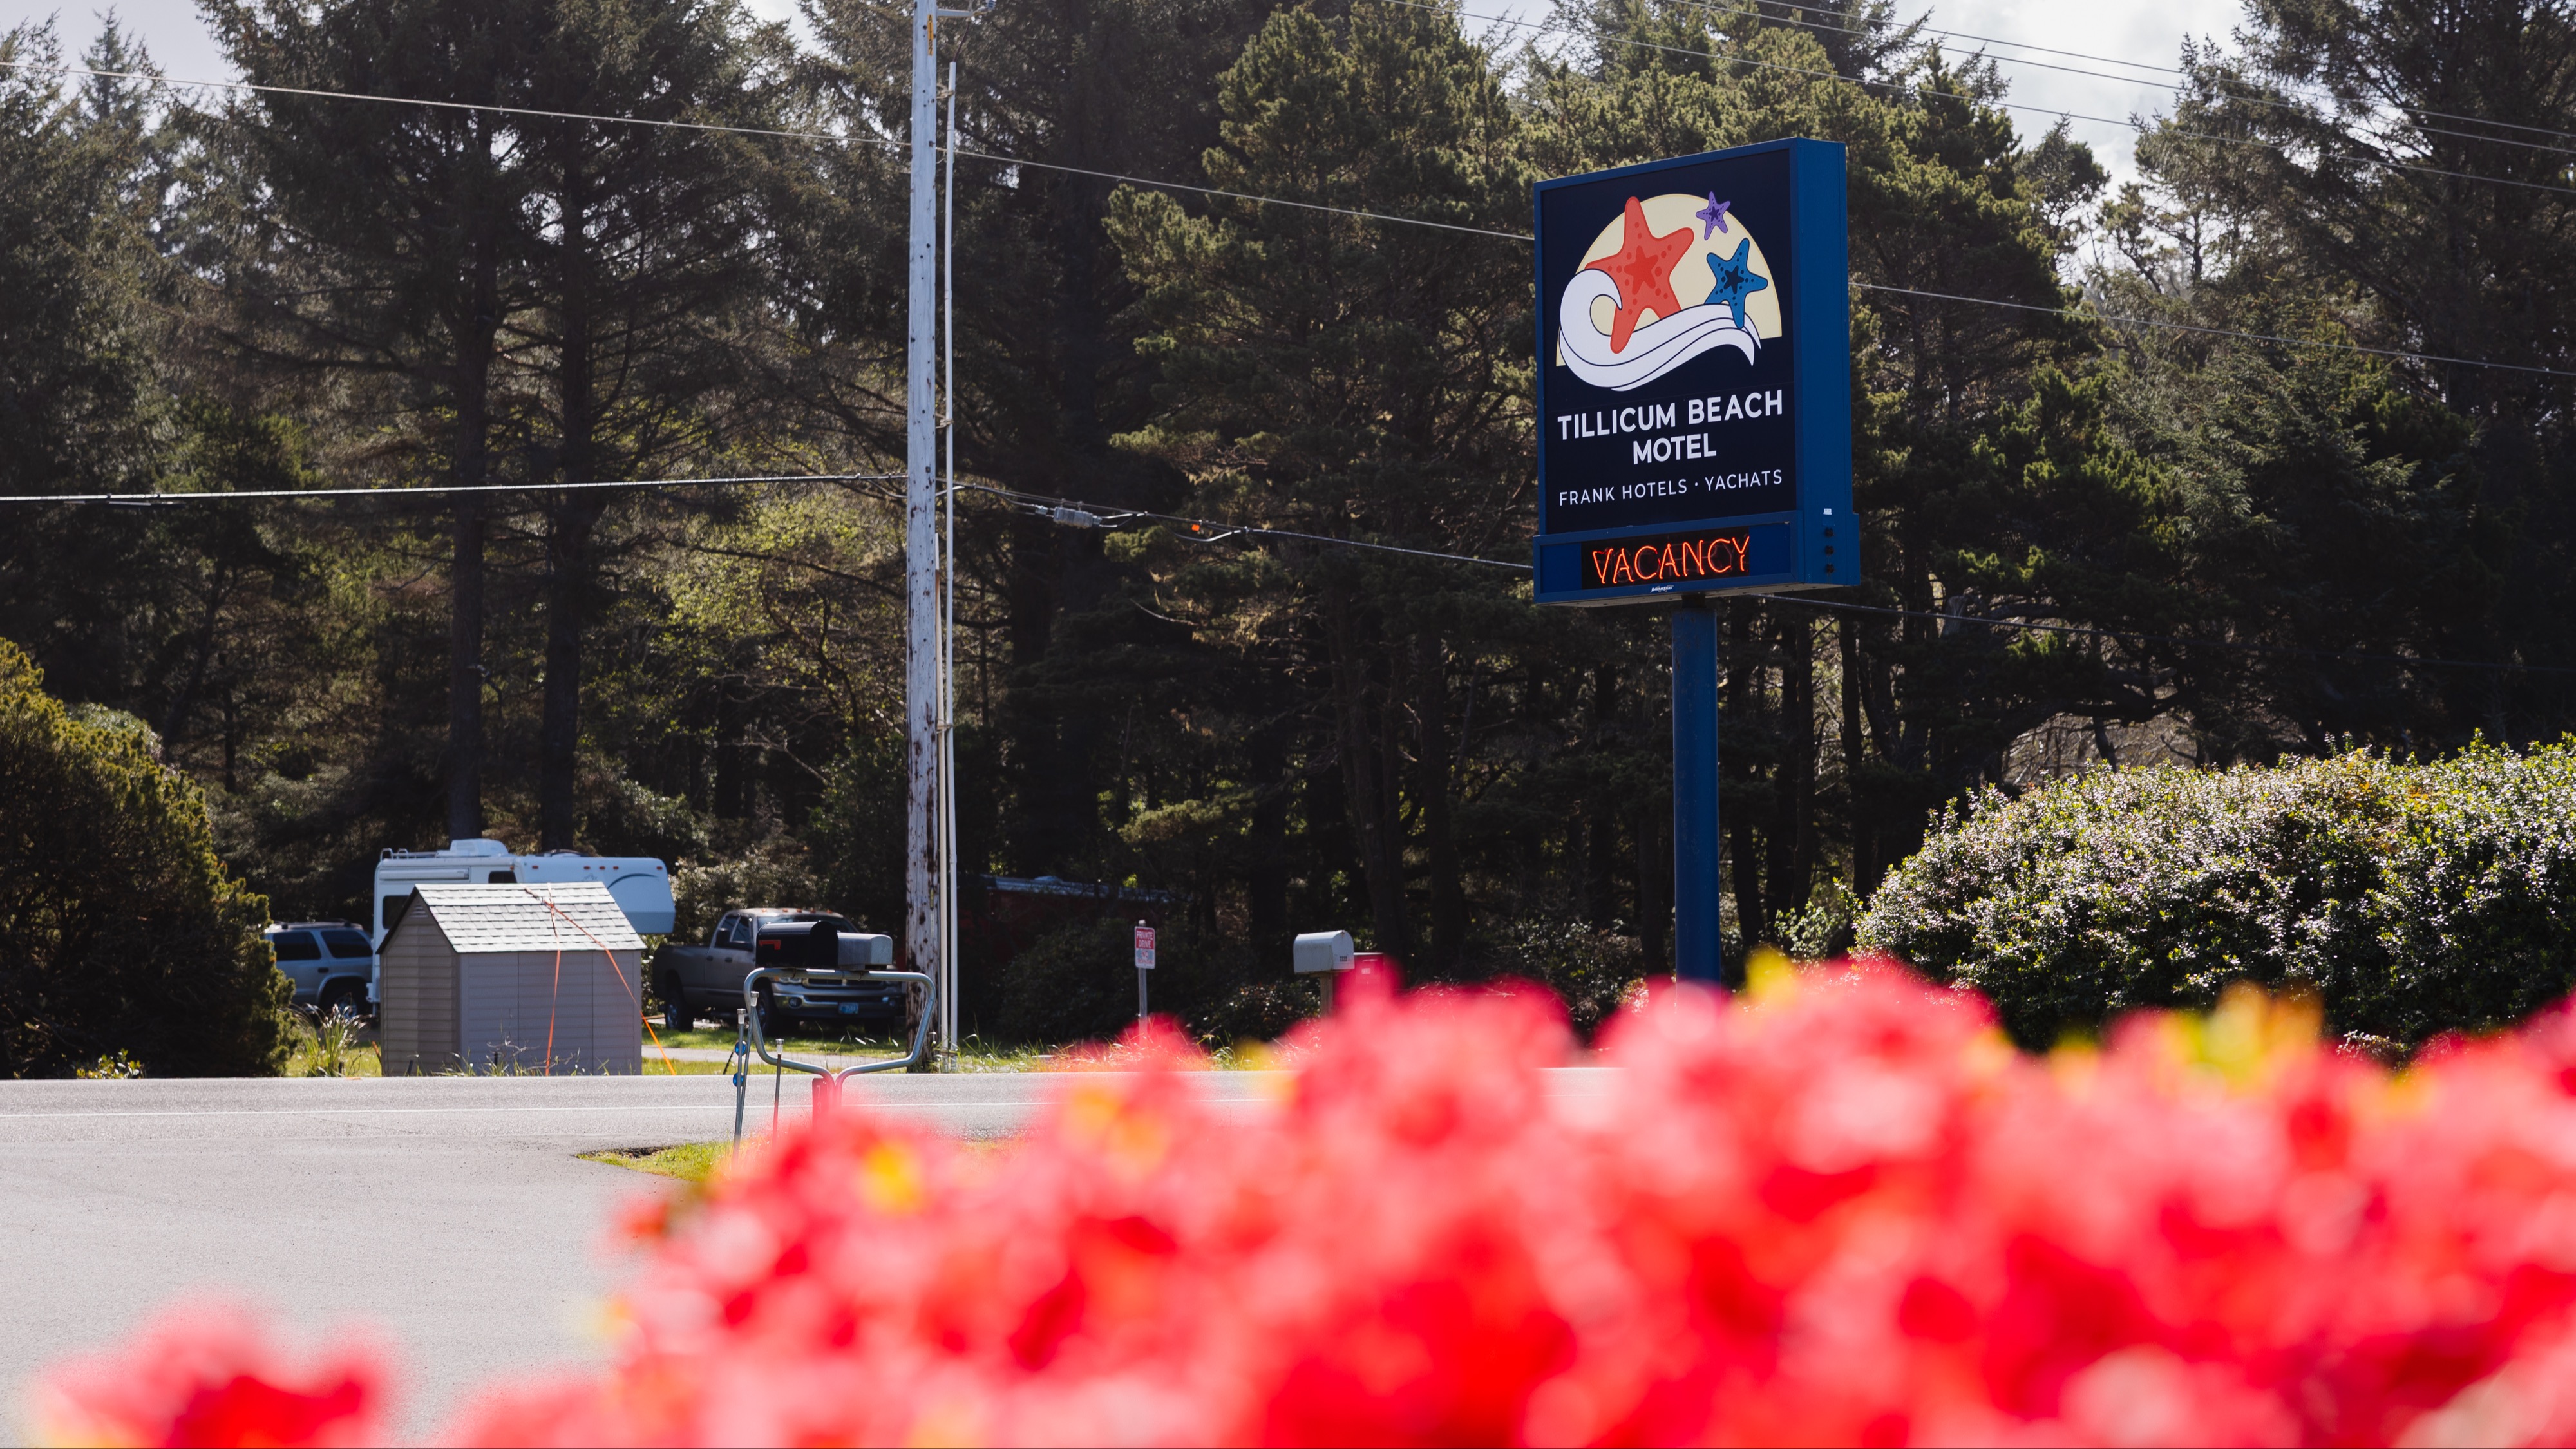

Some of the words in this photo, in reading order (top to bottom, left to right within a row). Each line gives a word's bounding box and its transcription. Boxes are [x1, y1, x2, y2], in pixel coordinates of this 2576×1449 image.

[1557, 402, 1675, 440] TILLICUM
[1688, 390, 1782, 424] BEACH
[1633, 433, 1717, 465] MOTEL
[1559, 486, 1615, 506] FRANK
[1622, 479, 1687, 499] HOTELS
[1704, 469, 1782, 491] YACHATS
[1592, 536, 1750, 584] VACANCY
[1137, 930, 1153, 940] PRIVATE
[1139, 939, 1151, 949] DRIVE
